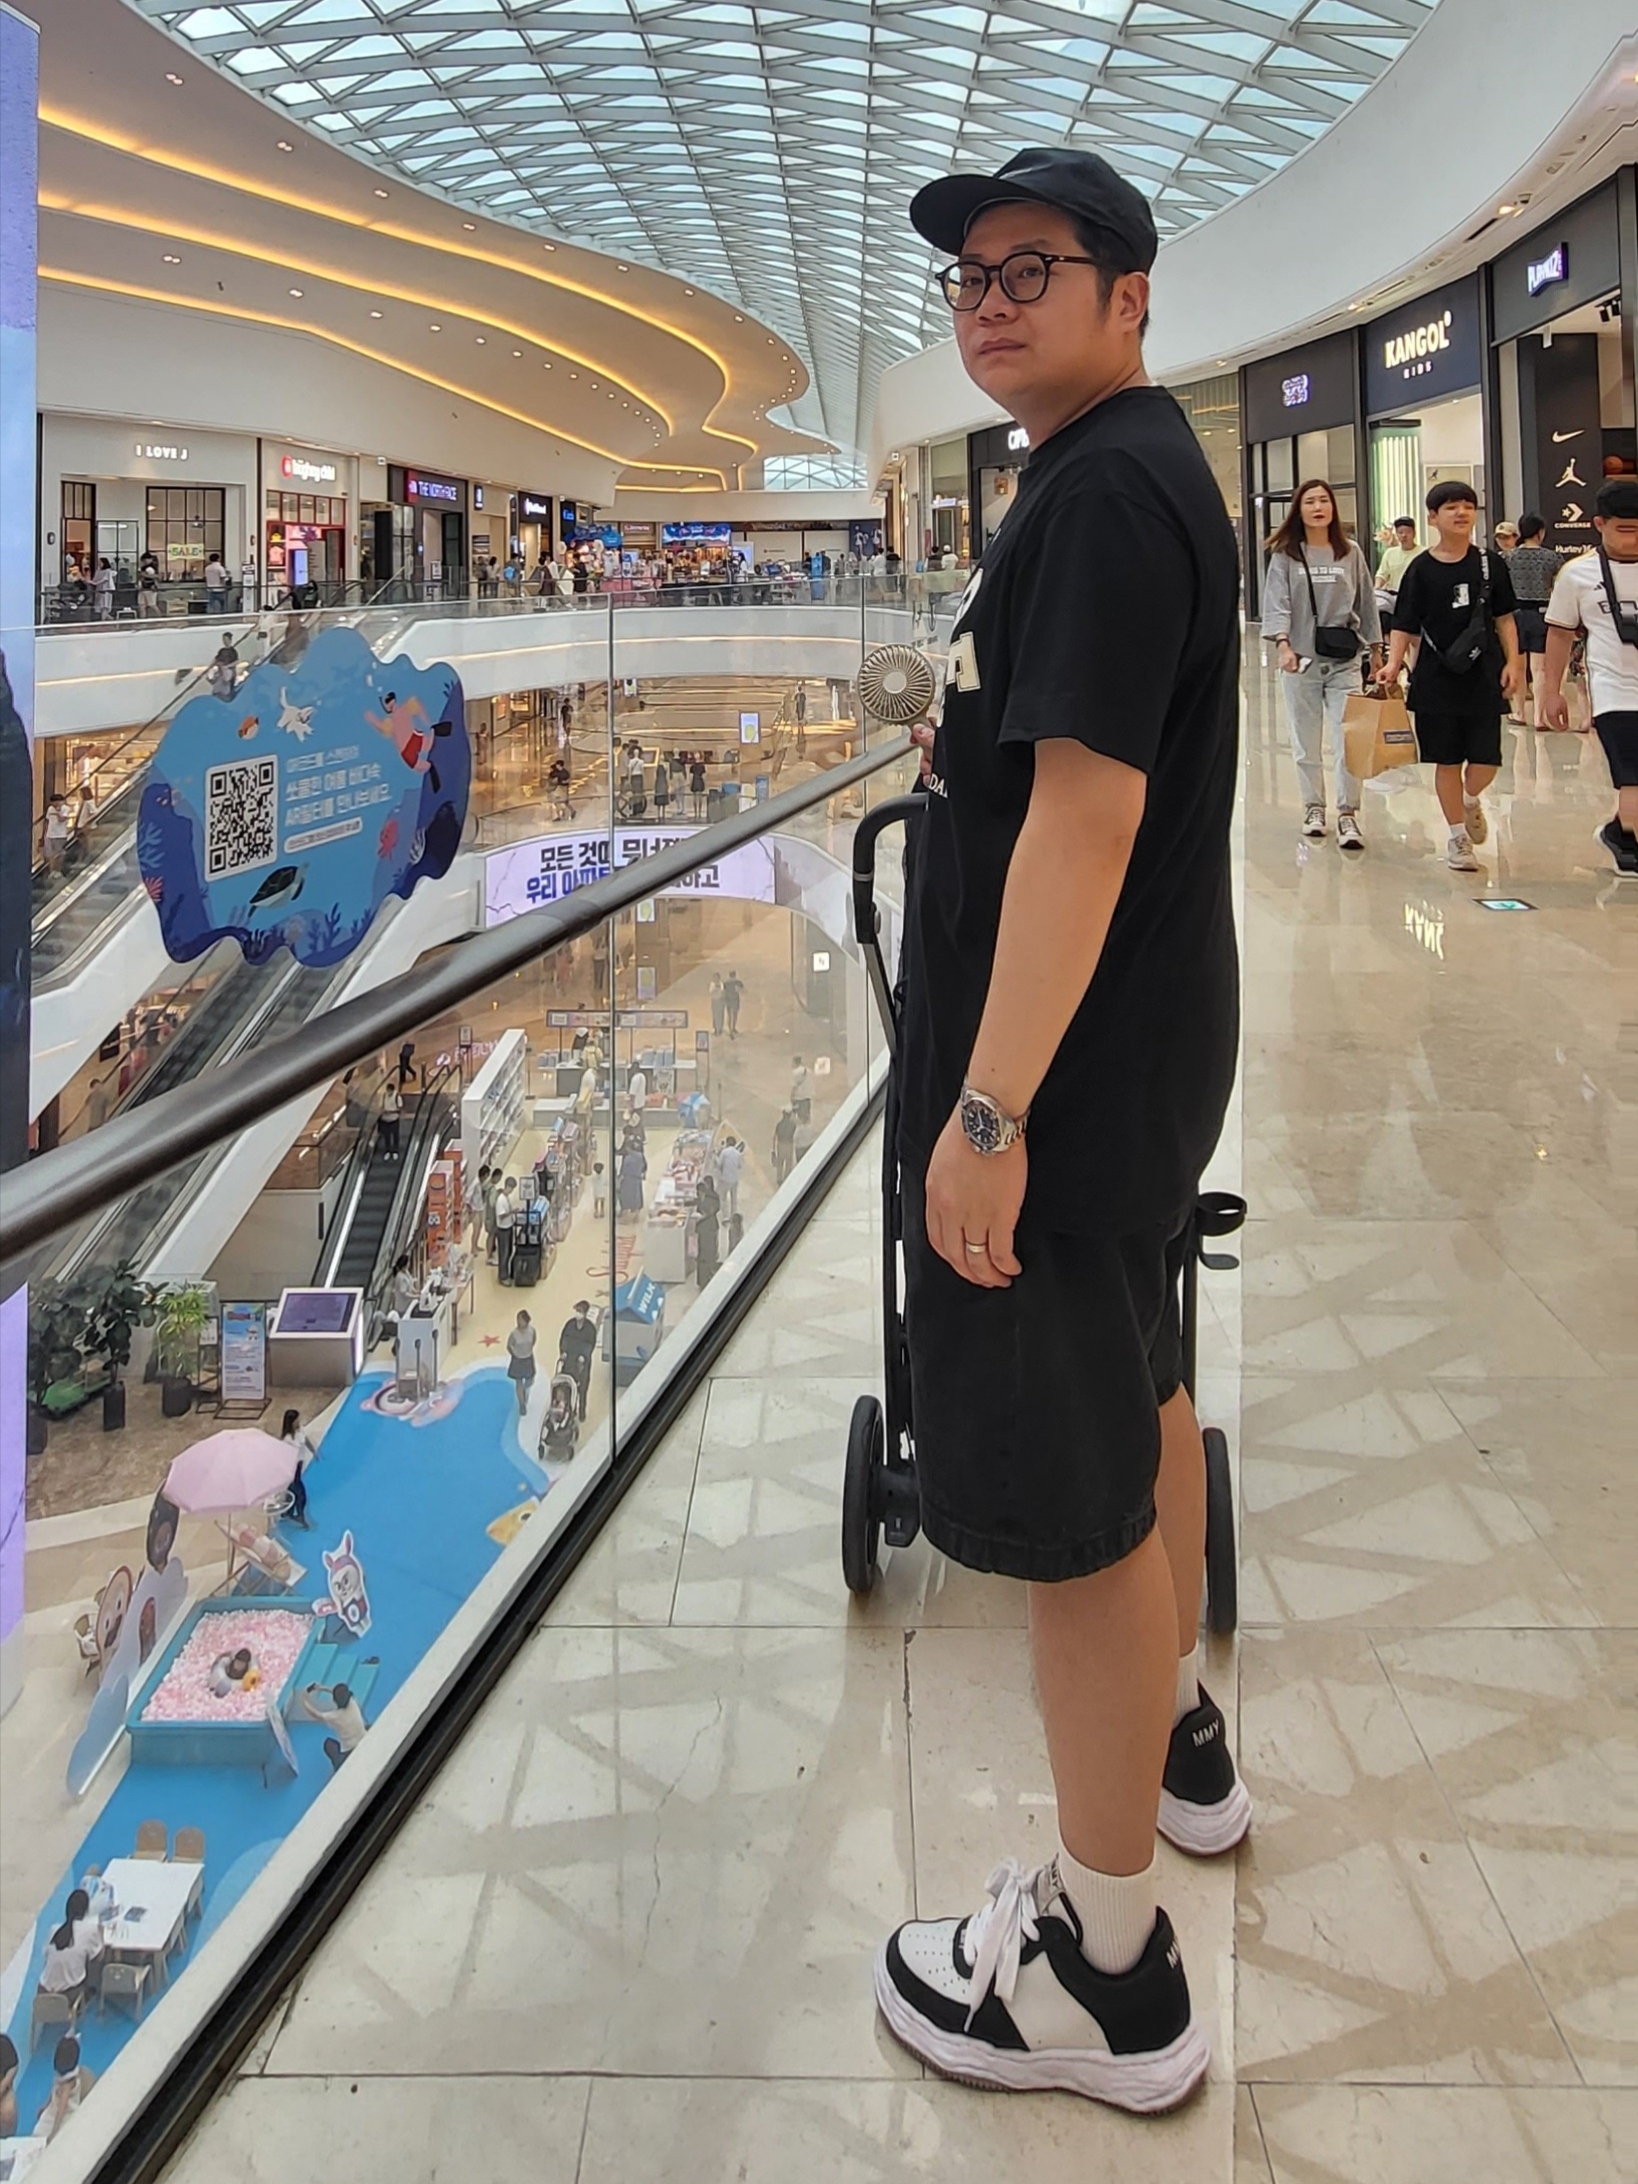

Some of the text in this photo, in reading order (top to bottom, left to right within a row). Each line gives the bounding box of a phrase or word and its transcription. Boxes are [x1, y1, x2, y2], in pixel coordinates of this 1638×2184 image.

[1384, 319, 1451, 369] KANGOL
[135, 444, 188, 461] I LOVE J
[171, 547, 199, 556] SALE
[1555, 544, 1583, 554] Hurley
[540, 844, 574, 873] 모든
[526, 873, 557, 904] 우리
[1191, 1717, 1219, 1748] MMY
